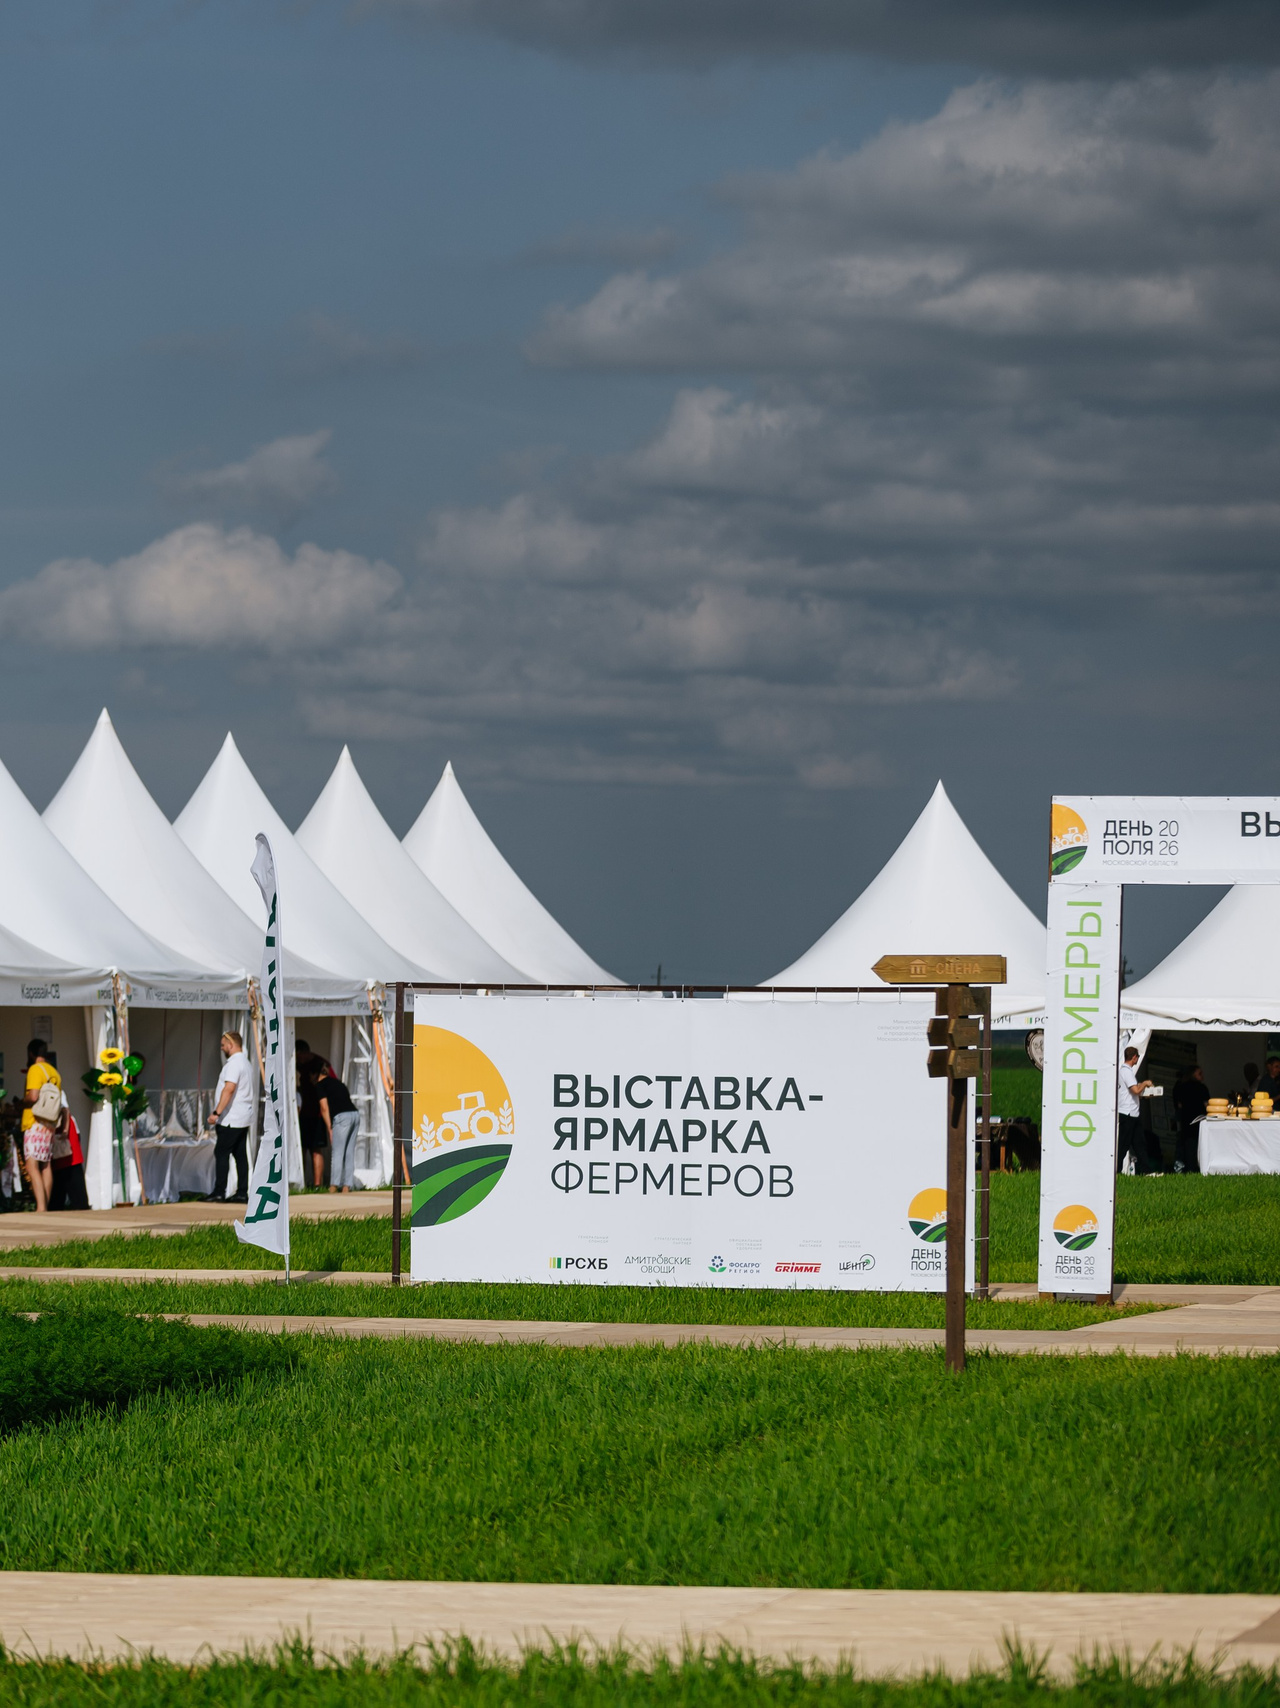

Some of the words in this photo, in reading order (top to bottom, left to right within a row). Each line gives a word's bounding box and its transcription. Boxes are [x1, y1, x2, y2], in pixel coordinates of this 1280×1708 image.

[1103, 820, 1153, 839] ДЕНЬ
[1158, 820, 1179, 837] 20
[1103, 840, 1153, 856] ПОЛЯ
[1158, 840, 1179, 856] 26
[1148, 859, 1179, 867] ОБЛАСТИ
[935, 962, 982, 975] СЦЕНА
[21, 983, 61, 1003] Каравай-СВ
[1059, 901, 1103, 1147] ФЕРМЕРЫ
[553, 1074, 823, 1111] ВЫСТАВКА-
[552, 1116, 771, 1154] ЯРМАРКА
[551, 1160, 795, 1198] ФЕРМЕРОВ
[911, 1249, 942, 1260] ДЕНЬ
[1055, 1255, 1082, 1266] ДЕНЬ
[1084, 1256, 1095, 1265] 20
[565, 1257, 608, 1270] РСХБ
[640, 1265, 676, 1274] ОВОЩИ
[775, 1262, 822, 1273] GRIMME
[839, 1260, 868, 1272] ЦЕНТР
[911, 1261, 942, 1271] ПОЛЯ
[1055, 1266, 1082, 1275] ПОЛЯ
[1084, 1267, 1095, 1275] 26
